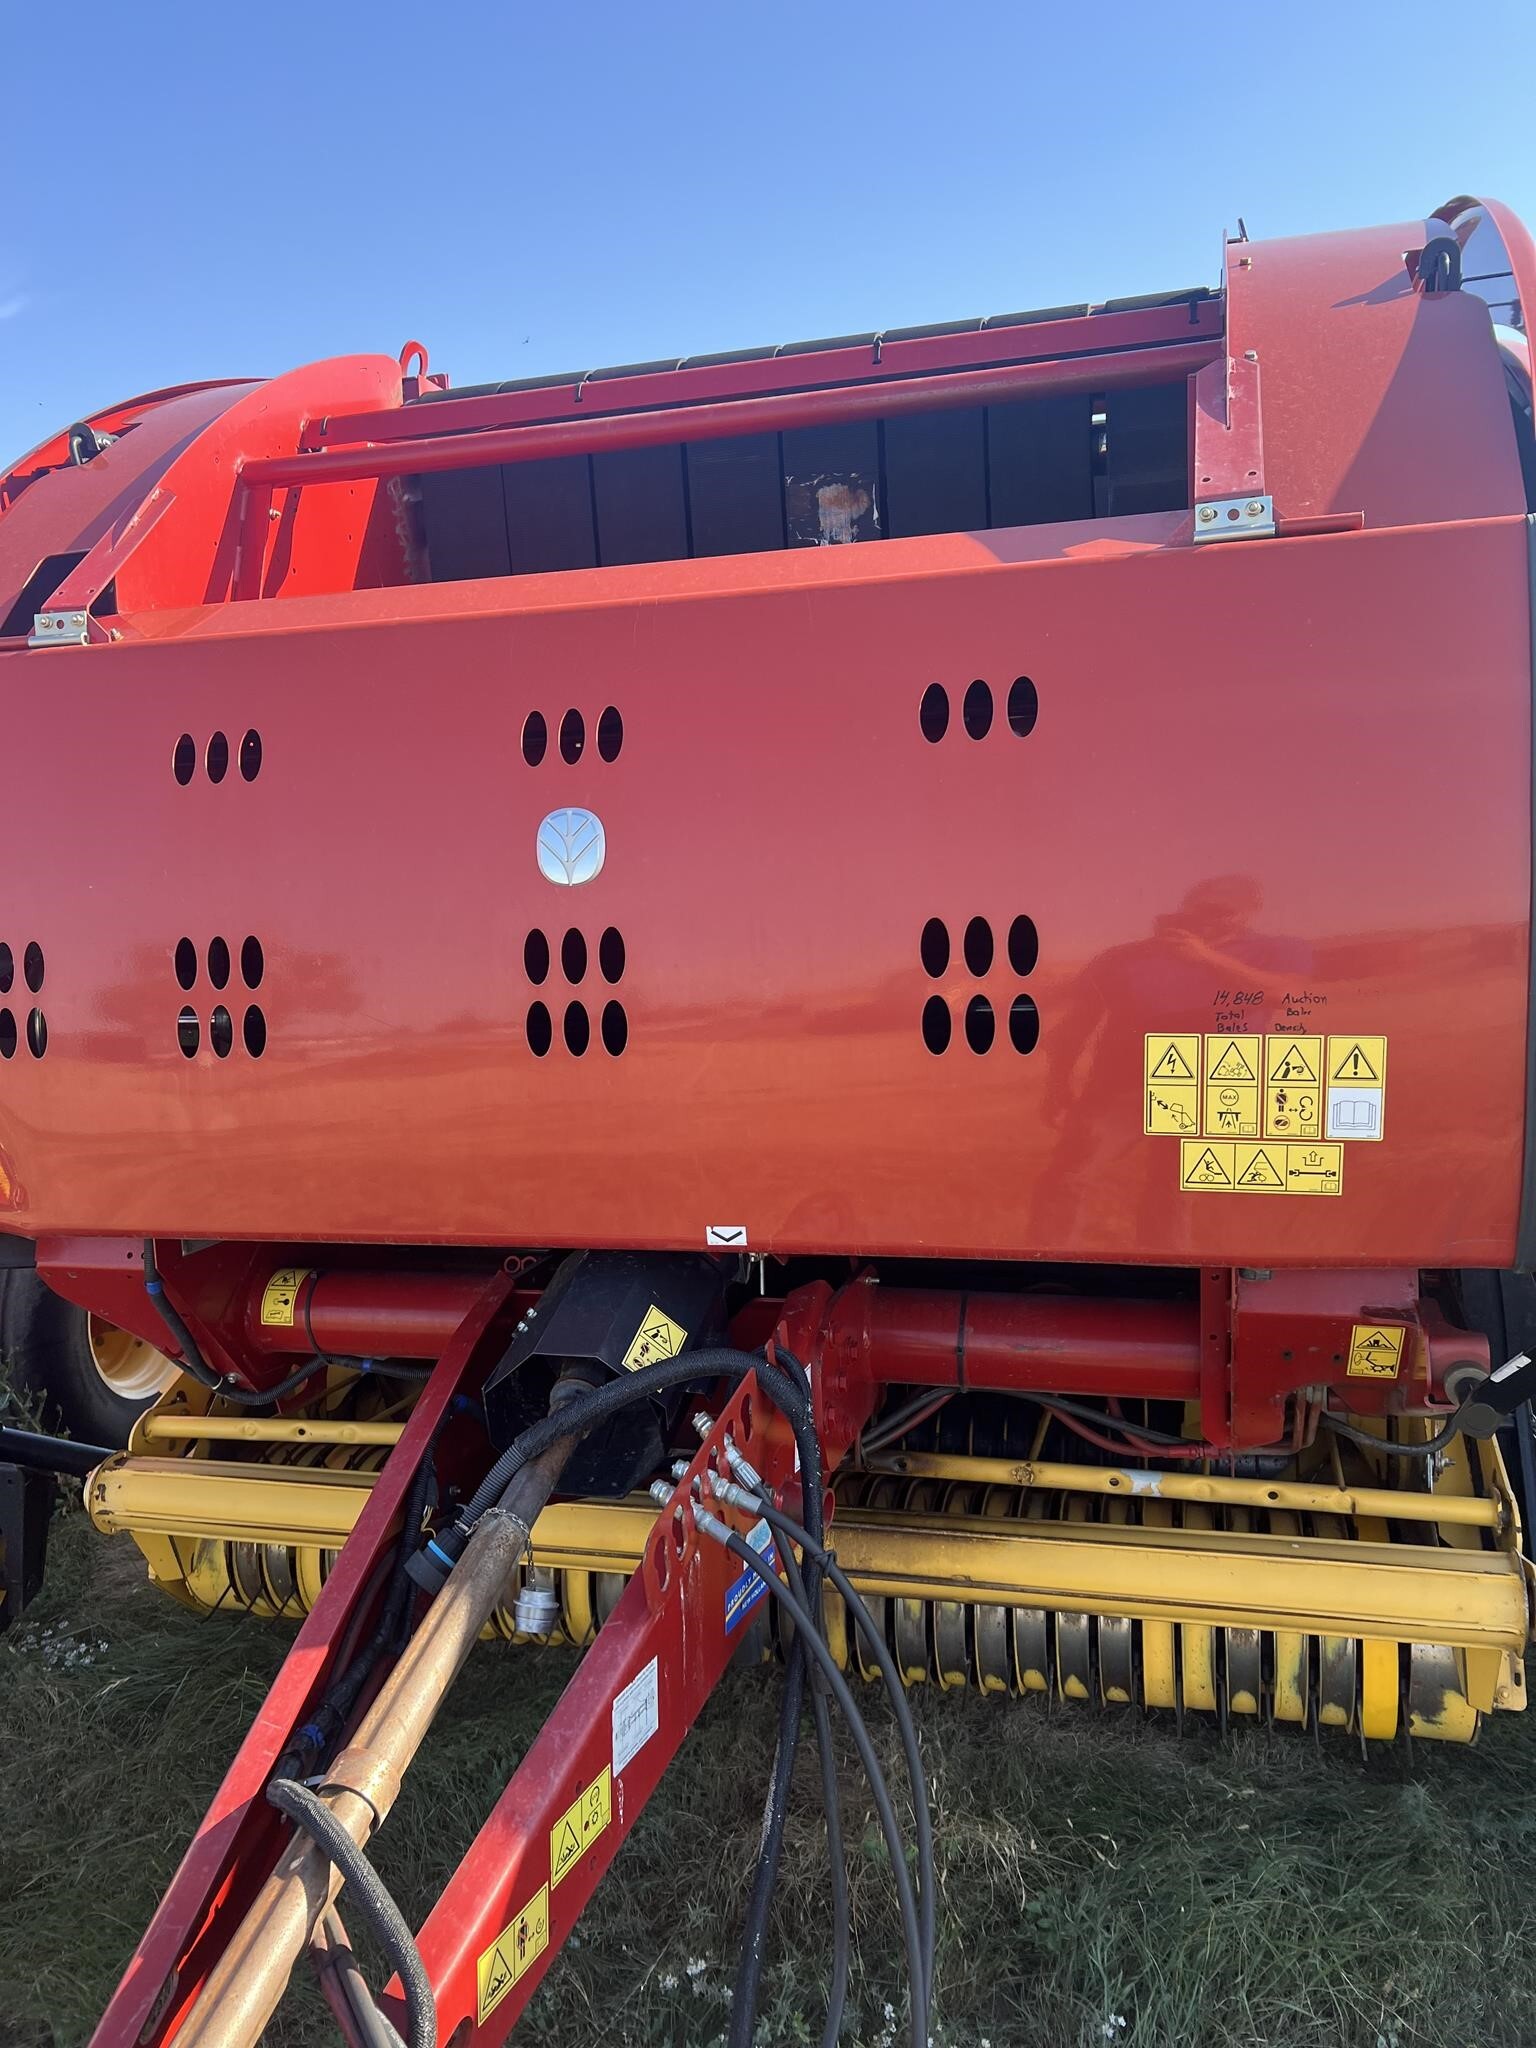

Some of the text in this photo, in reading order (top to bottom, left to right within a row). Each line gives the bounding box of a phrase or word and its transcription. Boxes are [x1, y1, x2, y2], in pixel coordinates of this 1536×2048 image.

[1213, 990, 1264, 1007] 14,848
[1281, 990, 1328, 1006] Auction
[1215, 1009, 1245, 1022] Total
[727, 1577, 752, 1612] PROUDLY
